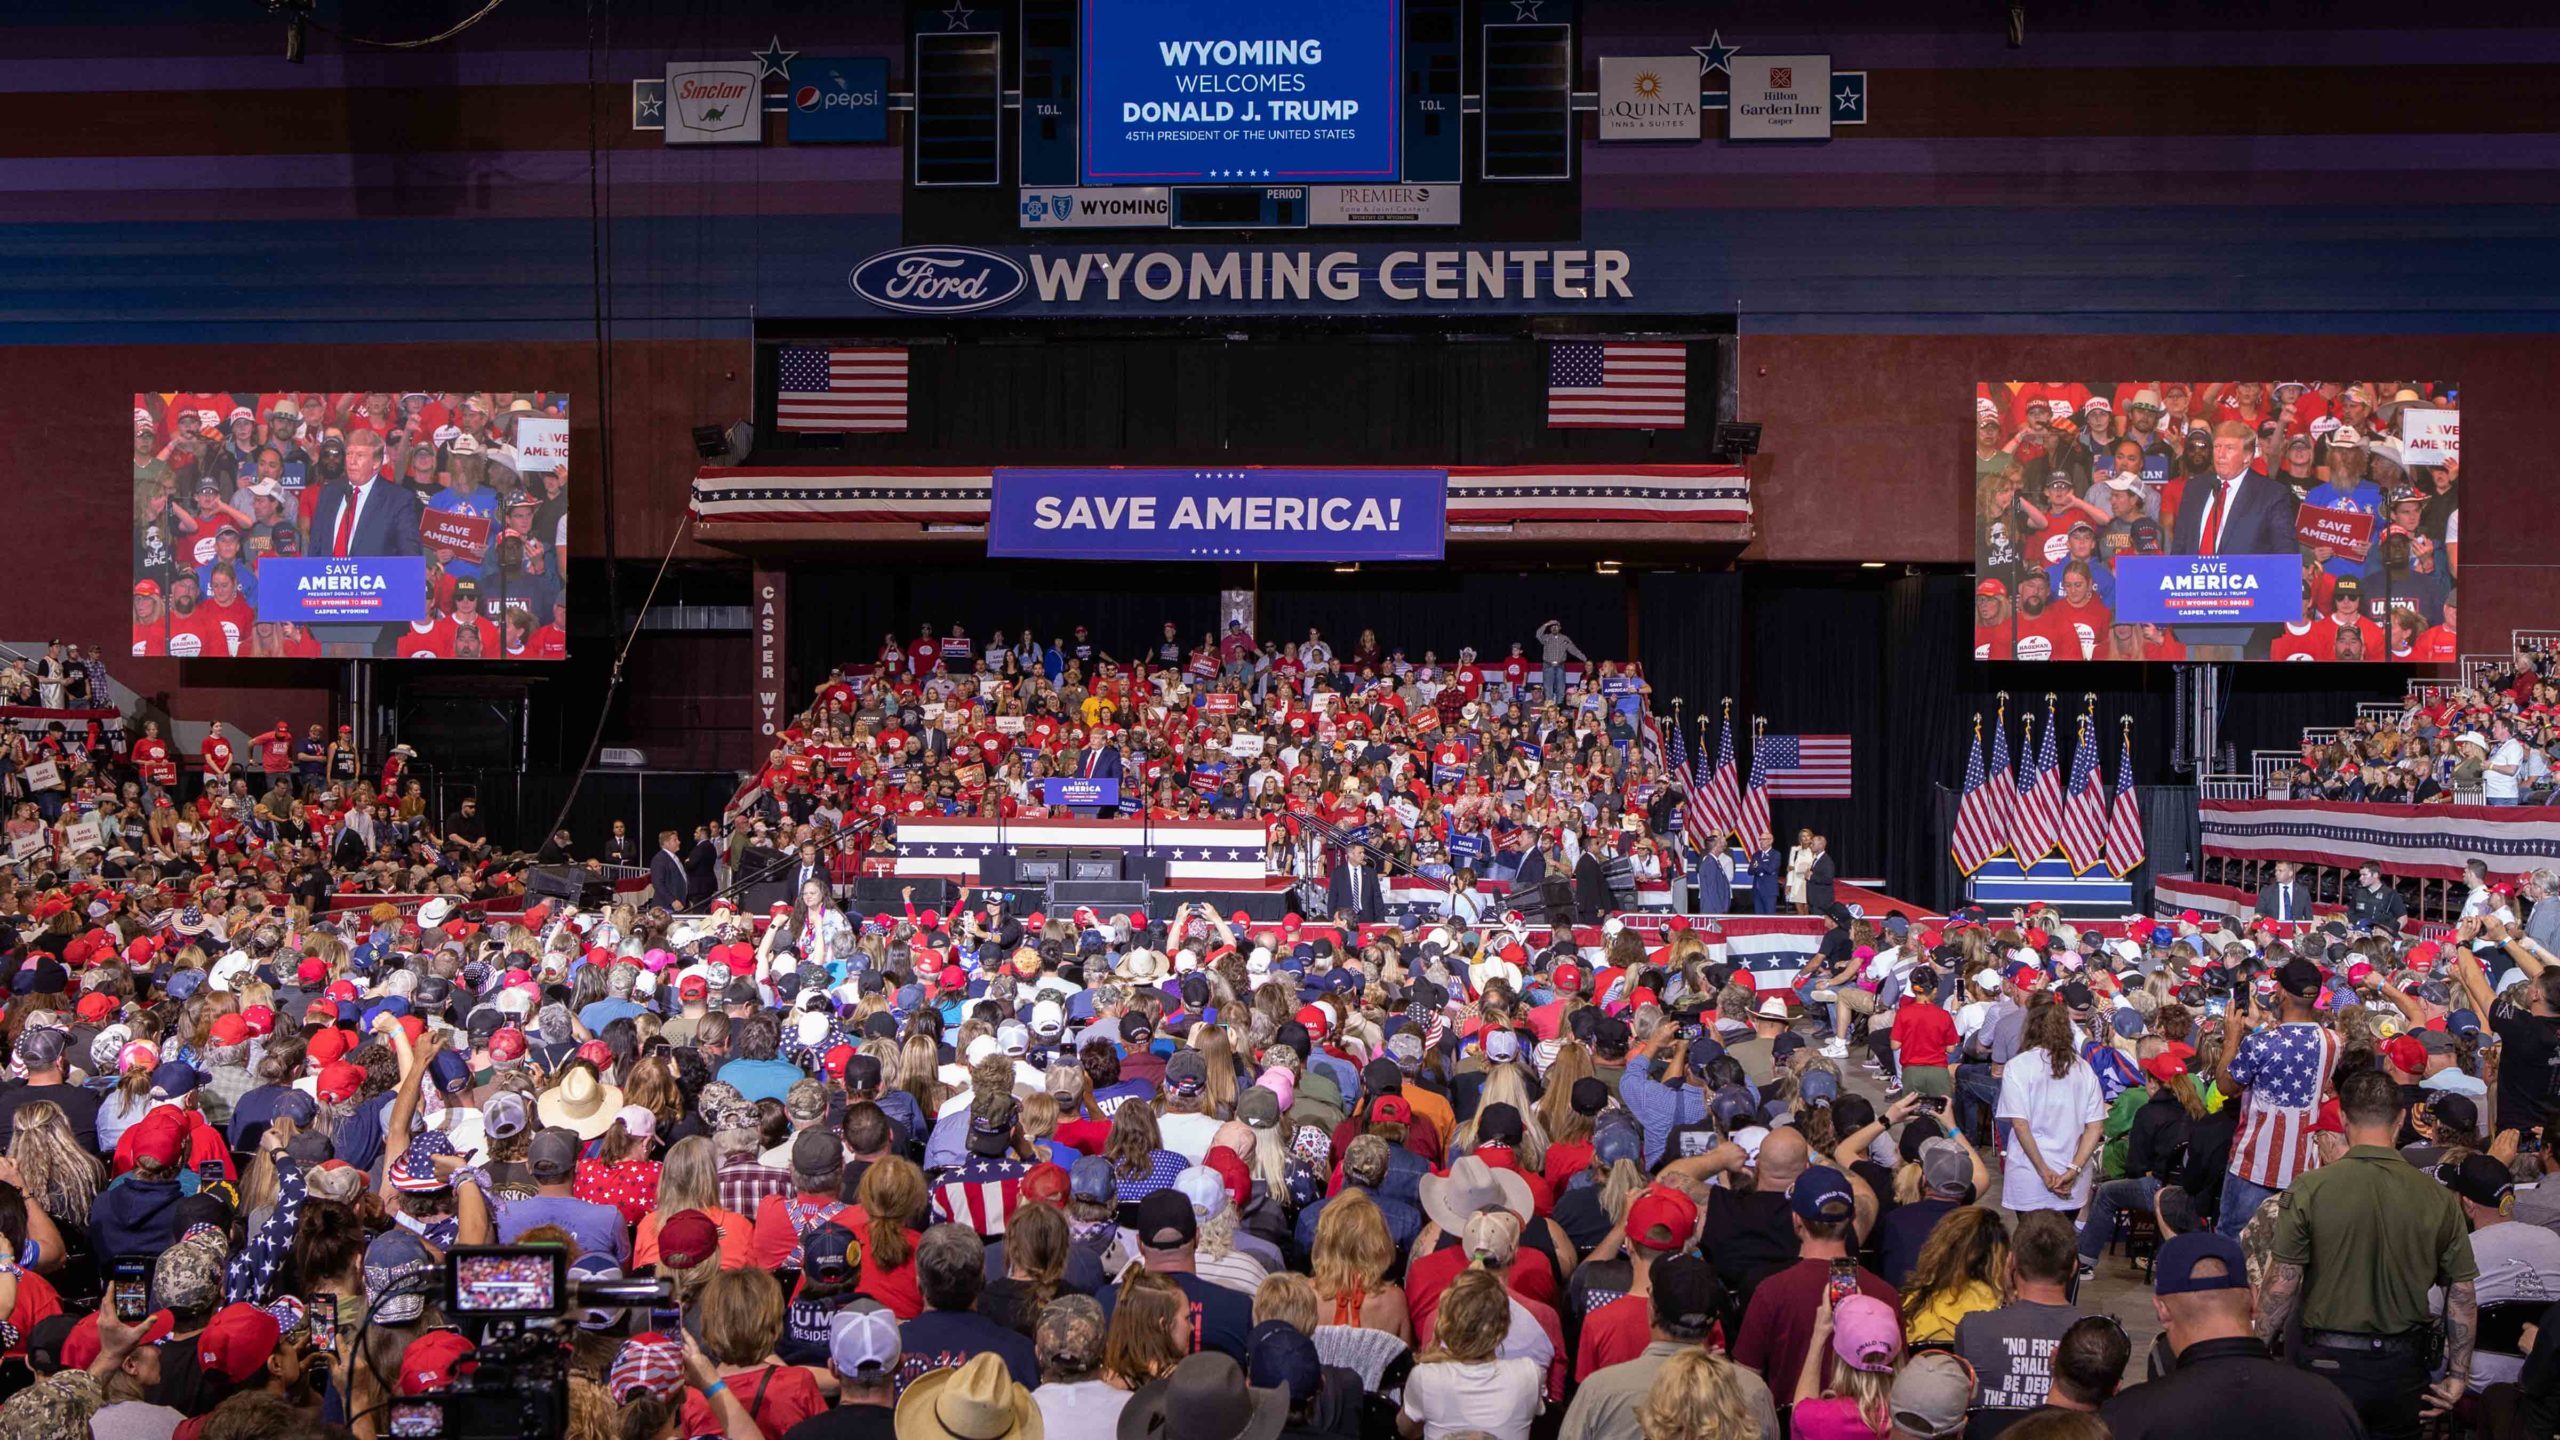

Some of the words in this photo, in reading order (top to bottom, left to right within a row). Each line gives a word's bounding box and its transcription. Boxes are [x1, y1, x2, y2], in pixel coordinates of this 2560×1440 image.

[1159, 39, 1322, 66] WYOMING
[679, 80, 747, 100] Sinclair
[1175, 74, 1306, 93] WELCOMES
[825, 90, 879, 109] pepsi
[1763, 92, 1798, 101] Hilton
[1037, 105, 1062, 115] T.O.L.
[1123, 101, 1234, 122] DONALD
[1240, 101, 1261, 121] J.
[1268, 100, 1359, 121] TRUMP
[1420, 102, 1445, 111] T.O.L.
[1616, 101, 1696, 119] QUINTA
[1740, 104, 1792, 116] Garden
[1795, 104, 1821, 115] Inn
[1648, 120, 1685, 128] SUITES
[1125, 131, 1154, 141] 45TH
[1157, 131, 1220, 141] PRESIDENT
[1223, 130, 1239, 140] OF
[1243, 130, 1265, 140] THE
[1268, 129, 1311, 140] UNITED
[1313, 129, 1356, 140] STATES
[1267, 189, 1302, 199] PERIOD
[1340, 188, 1414, 203] PREMIER
[1081, 199, 1168, 215] WYOMING
[885, 256, 991, 300] Ford
[1029, 251, 1359, 301] WYOMING
[1379, 250, 1633, 300] CENTER
[1033, 496, 1157, 531] SAVE
[1168, 496, 1401, 532] AMERICA!
[439, 522, 471, 537] SAVE
[2317, 518, 2352, 534] SAVE
[325, 564, 358, 575] SAVE
[2190, 562, 2228, 574] SAVE
[297, 574, 387, 590] AMERICA
[2159, 573, 2259, 590] AMERICA
[761, 586, 775, 679] CASPER
[1193, 663, 1216, 673] AMERICA!
[760, 692, 777, 735] WYO
[1417, 714, 1430, 723] SAVE
[32, 773, 57, 784] AMERICA!
[36, 768, 49, 776] SAVE
[1061, 785, 1101, 793] AMERICA
[73, 833, 99, 843] AMERICA!
[77, 828, 91, 836] SAVE
[21, 841, 35, 849] SAVE
[1452, 845, 1479, 853] AMERICA!
[2002, 1338, 2027, 1355] "NO
[2011, 1358, 2051, 1376] SHALL
[2002, 1375, 2020, 1392] BE
[2024, 1376, 2054, 1394] DEB
[1984, 1389, 2006, 1406] THE
